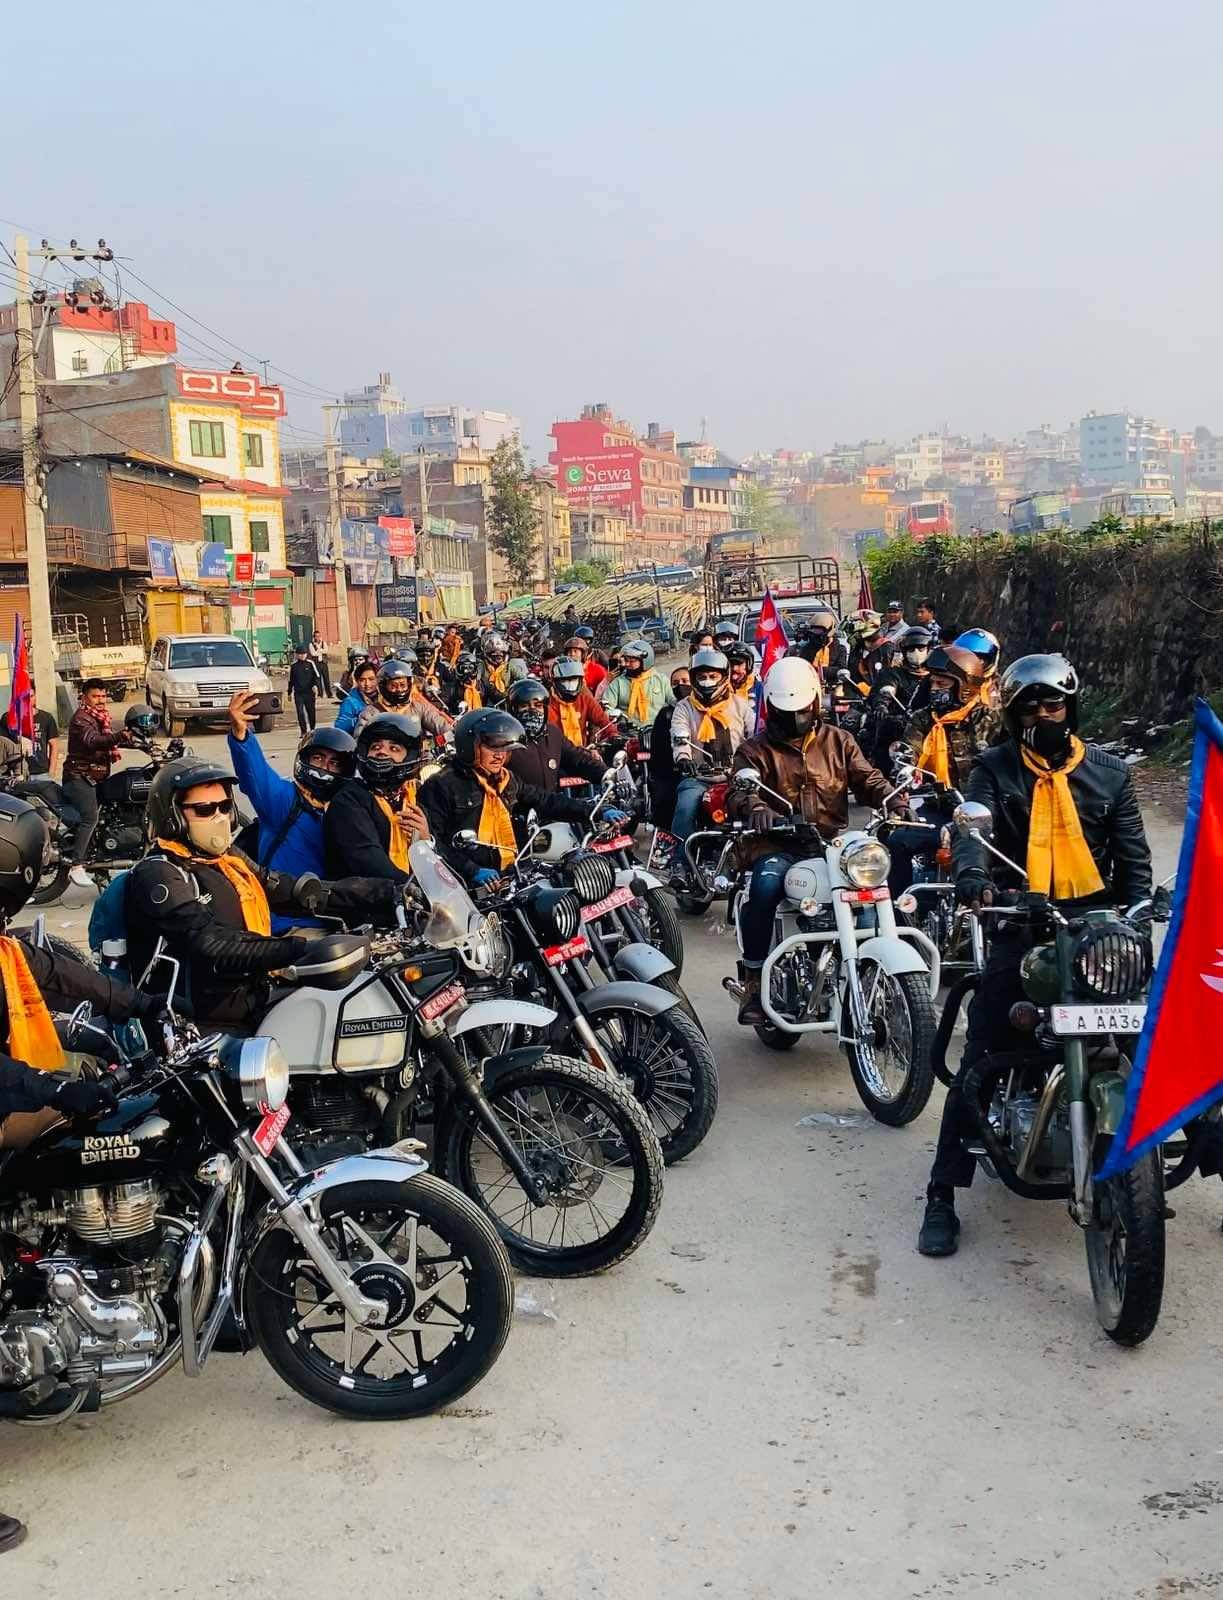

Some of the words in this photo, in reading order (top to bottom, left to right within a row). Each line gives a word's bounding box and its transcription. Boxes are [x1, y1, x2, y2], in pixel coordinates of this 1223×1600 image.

[344, 1023, 370, 1033] ROYAL
[372, 1020, 403, 1031] ENFIELD
[1077, 1015, 1087, 1029] A
[84, 1134, 133, 1150] ROYAL
[81, 1146, 141, 1165] ENFIELD
